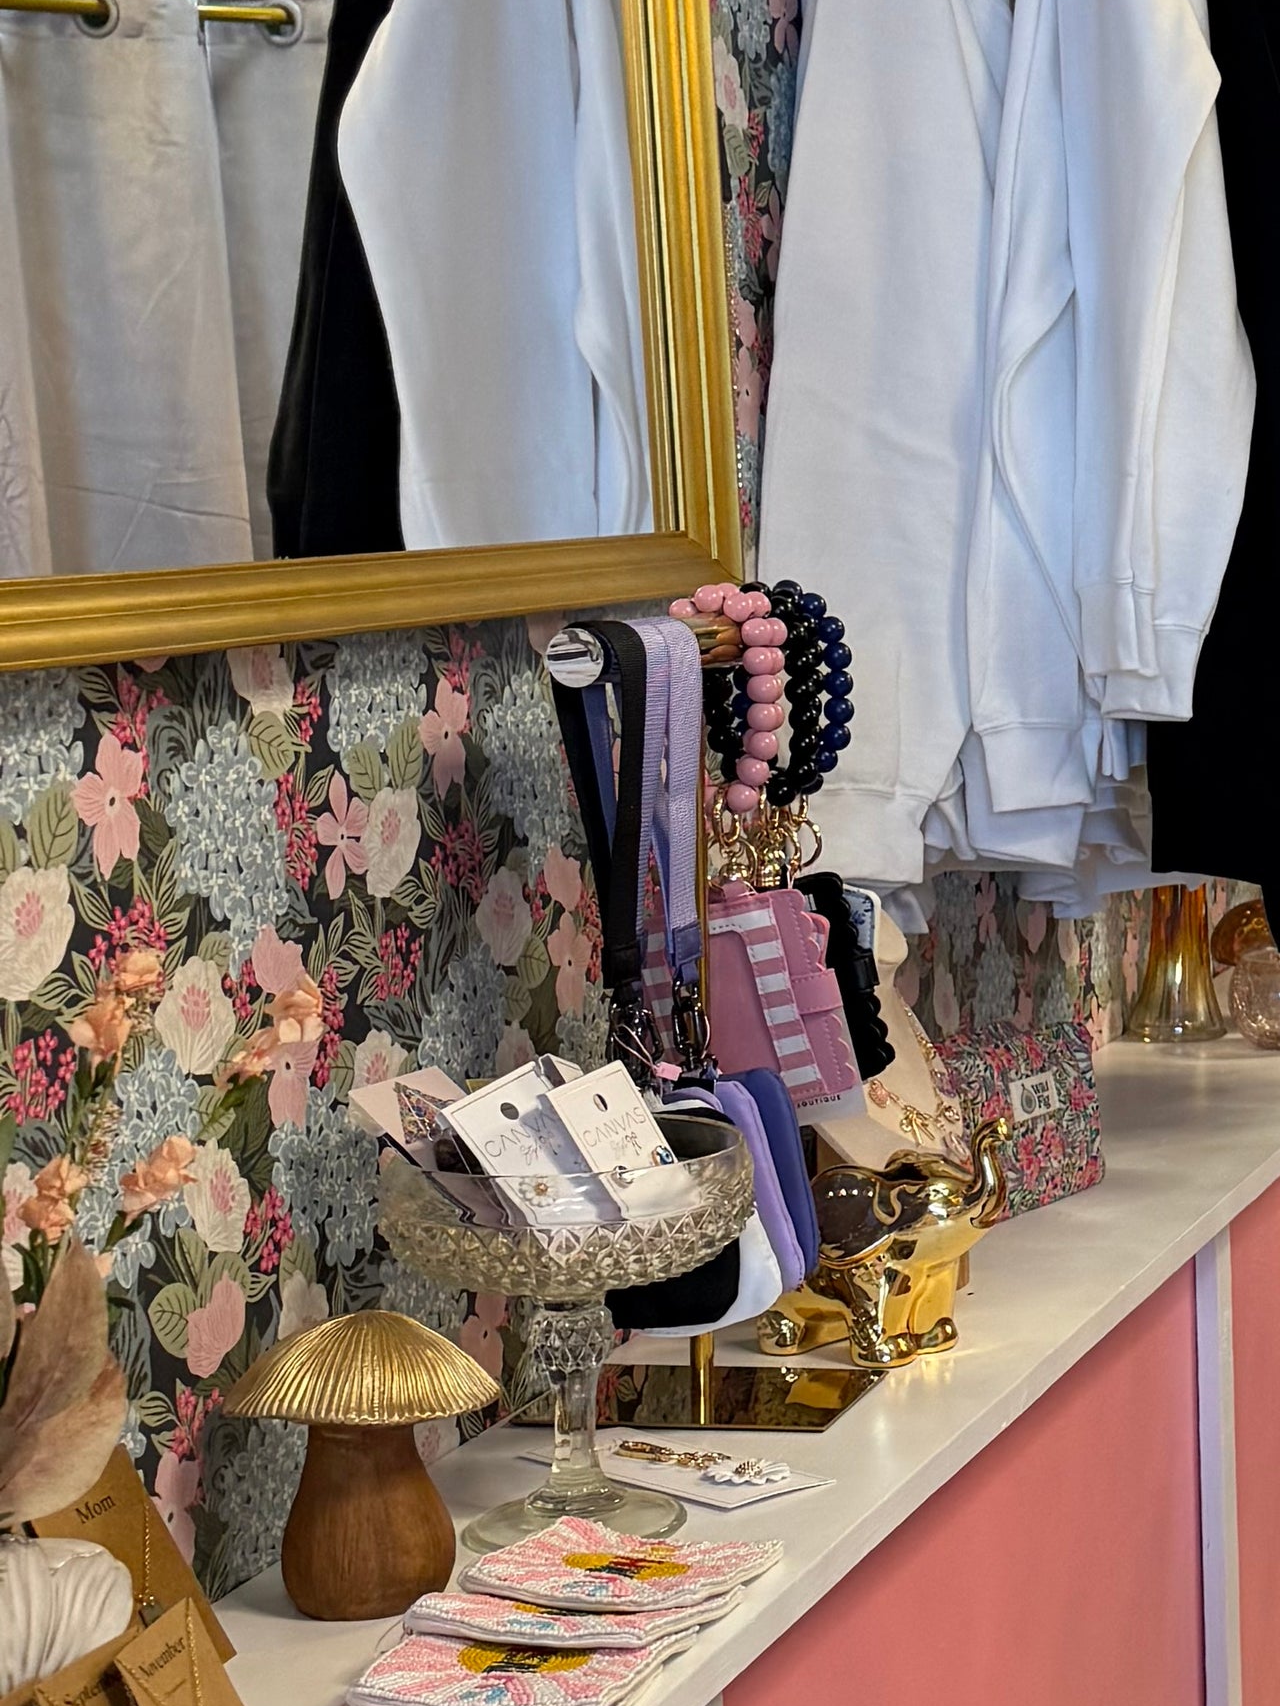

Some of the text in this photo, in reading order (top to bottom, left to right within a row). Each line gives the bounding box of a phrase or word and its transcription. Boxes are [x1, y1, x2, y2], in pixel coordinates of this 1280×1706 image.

[484, 1112, 557, 1158] CANVA
[582, 1105, 648, 1148] CANVAS
[74, 1494, 117, 1525] Mom
[138, 1636, 187, 1678] November
